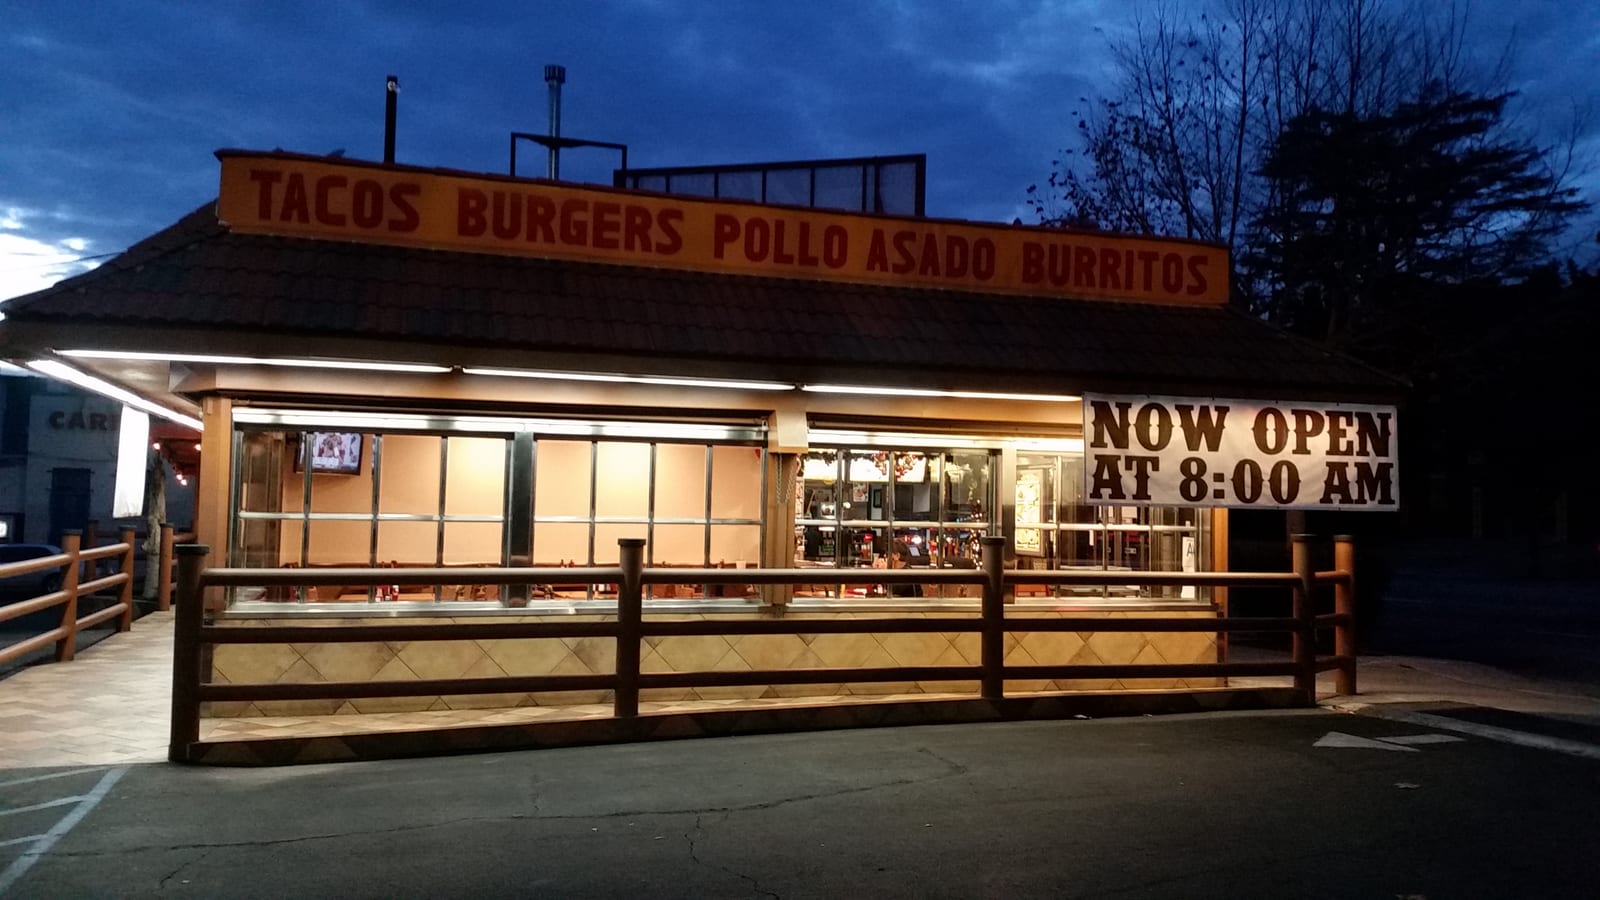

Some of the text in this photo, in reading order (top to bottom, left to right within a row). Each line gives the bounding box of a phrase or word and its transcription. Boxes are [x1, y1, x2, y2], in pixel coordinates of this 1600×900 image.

[250, 168, 1209, 295] TACOS BURGERS POLLO ASADO BURRITOS
[1090, 400, 1393, 457] NOW OPEN
[1089, 454, 1396, 505] AT 8:00 AM
